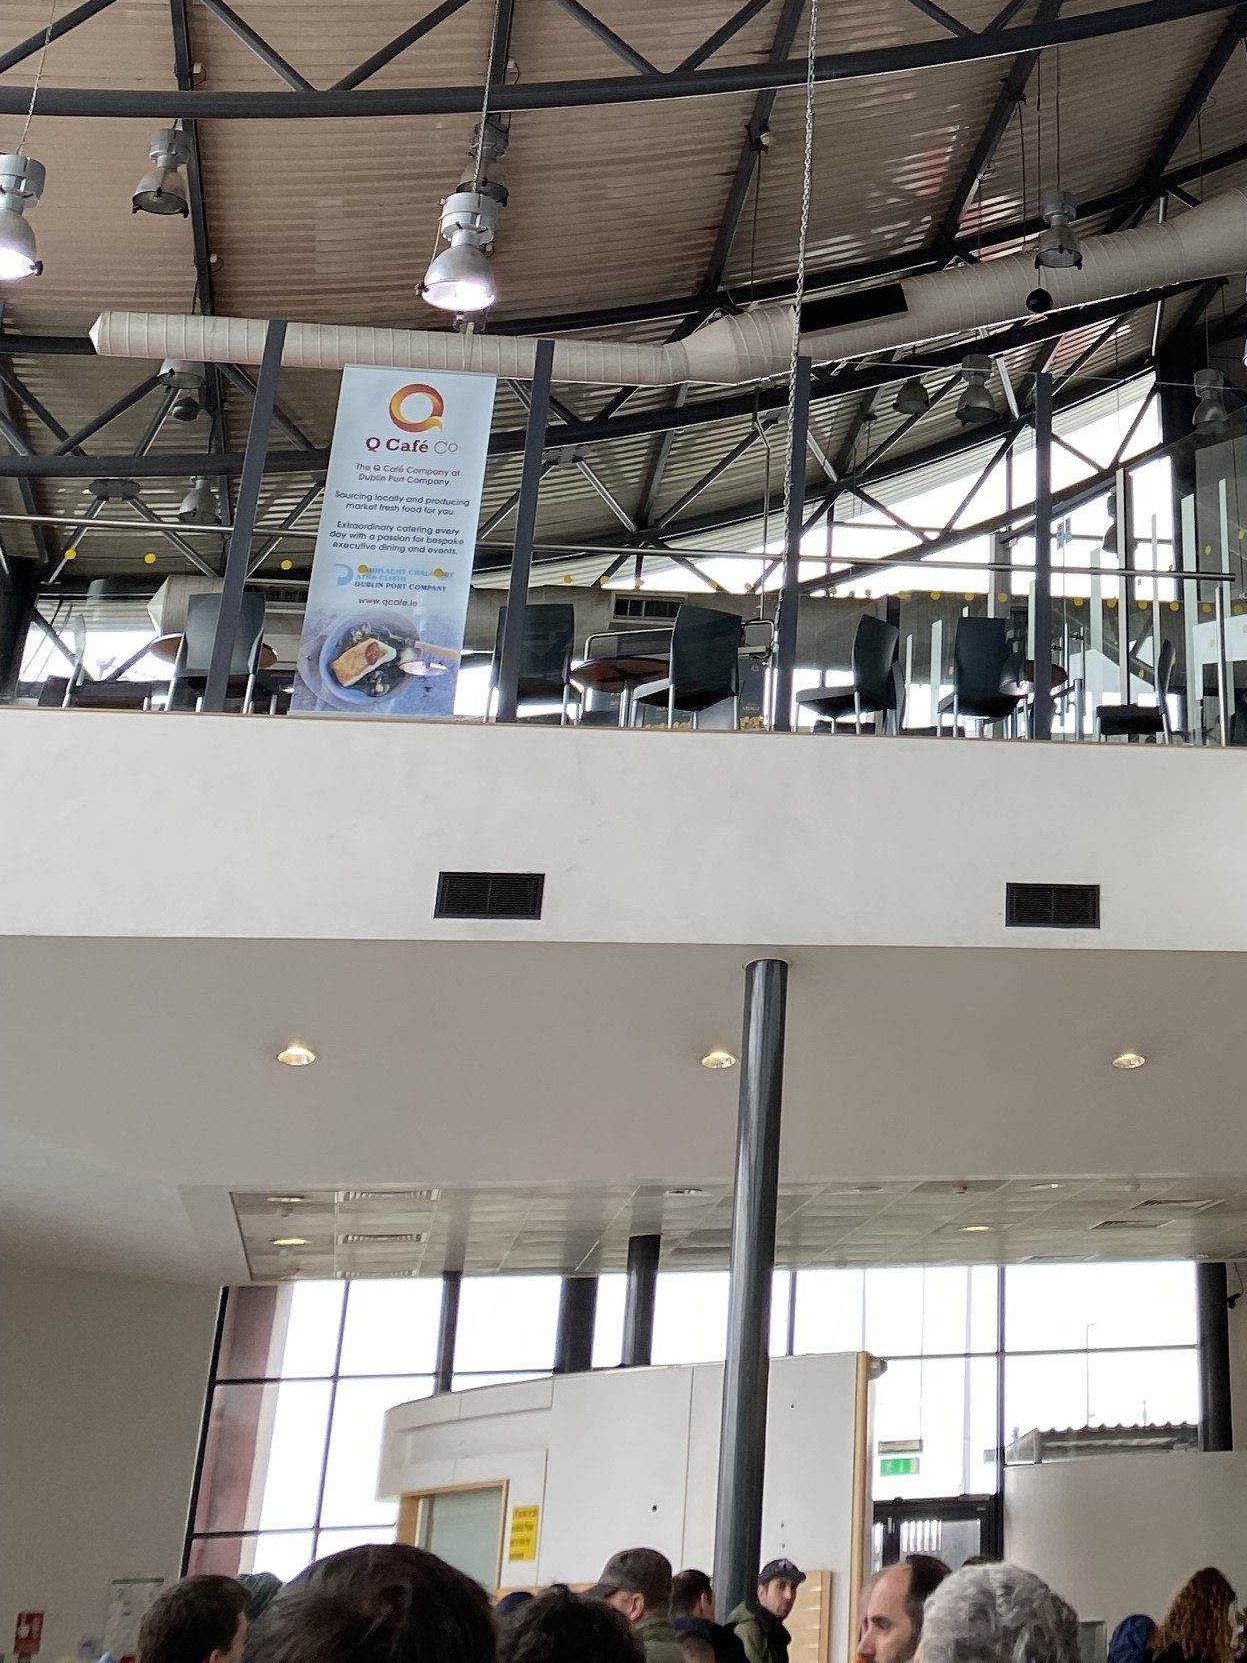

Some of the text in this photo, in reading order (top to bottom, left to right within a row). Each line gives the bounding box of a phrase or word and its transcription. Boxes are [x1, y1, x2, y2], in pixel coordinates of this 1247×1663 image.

[366, 437, 381, 453] Q
[386, 438, 429, 453] Café
[356, 463, 371, 471] The
[373, 464, 381, 472] Q
[383, 464, 404, 473] Café
[406, 466, 449, 477] Company
[359, 474, 386, 482] Dublin
[388, 475, 405, 483] Port
[335, 490, 470, 507] Sourcing locally and producing
[346, 502, 456, 516] market fresh food for you.
[337, 521, 460, 536] Extraordinary catering every
[330, 530, 347, 539] day
[377, 534, 410, 542] passion
[412, 535, 424, 543] for
[426, 537, 465, 546] bespoke
[332, 542, 376, 551] executive
[378, 544, 406, 553] dining
[428, 546, 458, 555] events.
[408, 584, 447, 592] COMPANY
